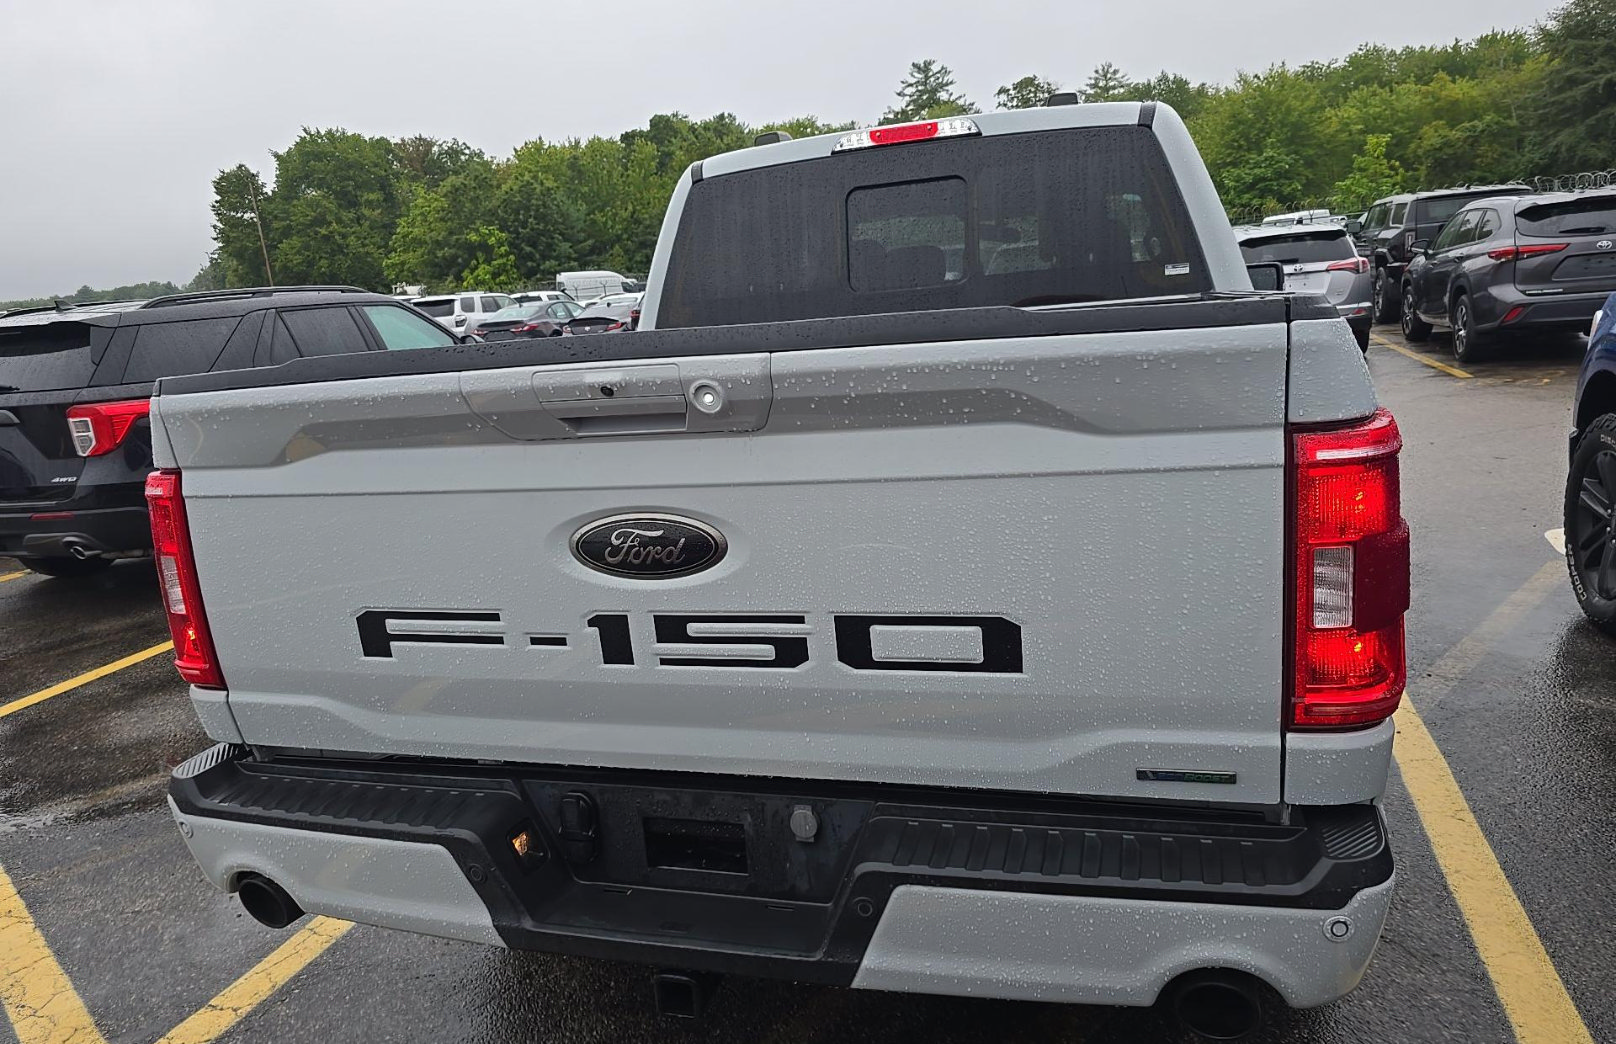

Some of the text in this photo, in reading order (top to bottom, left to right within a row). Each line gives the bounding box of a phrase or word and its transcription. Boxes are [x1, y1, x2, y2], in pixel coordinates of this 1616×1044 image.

[605, 528, 686, 565] Ford
[1567, 543, 1587, 600] COOPER
[356, 609, 1023, 674] F-150
